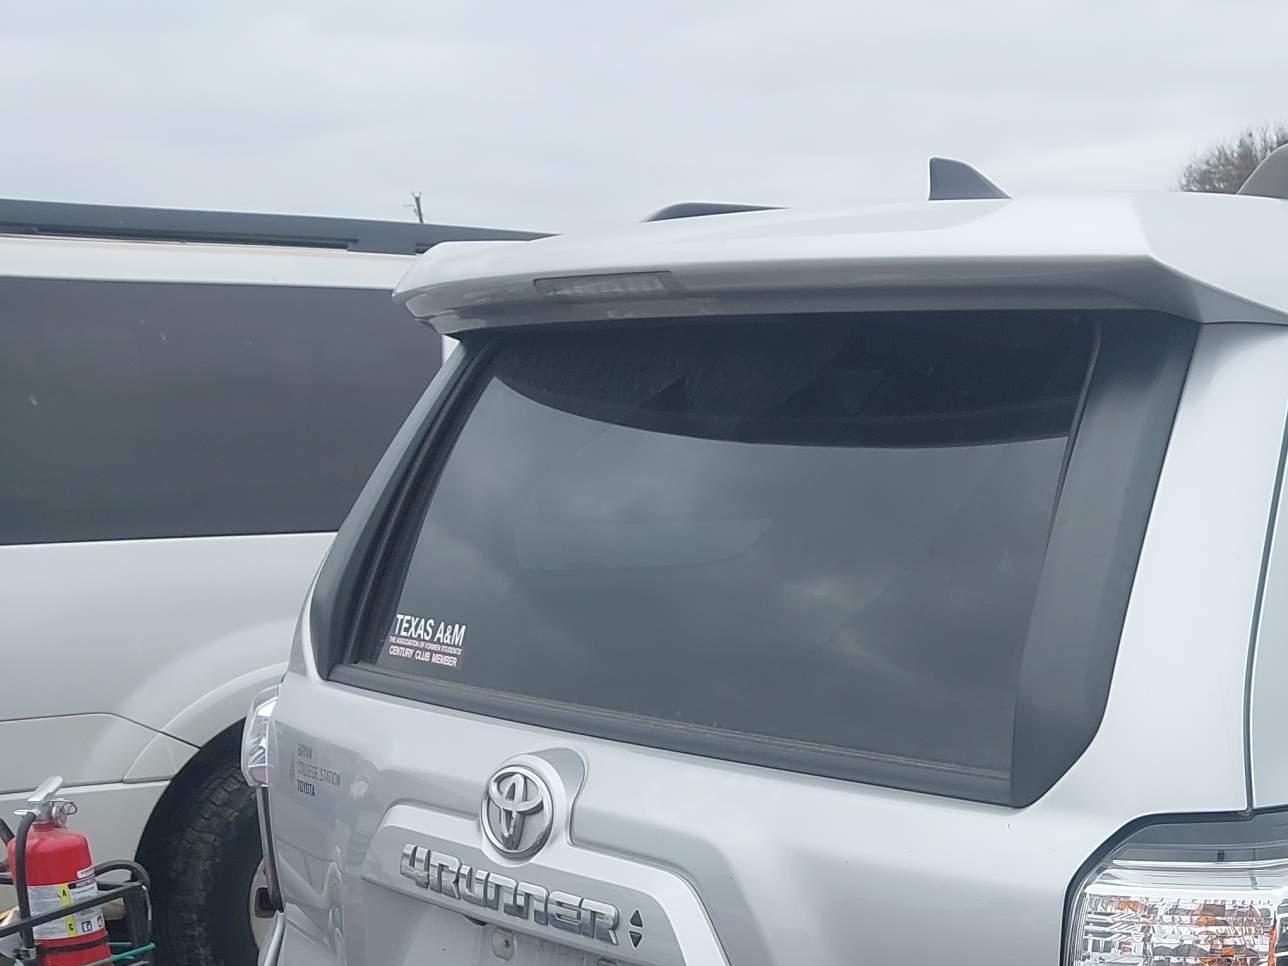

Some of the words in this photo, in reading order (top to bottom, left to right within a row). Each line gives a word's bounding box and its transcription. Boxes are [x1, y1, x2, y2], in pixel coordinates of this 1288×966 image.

[395, 614, 434, 640] TEXAS
[434, 621, 466, 647] A&M
[388, 645, 414, 658] CENTURY
[414, 650, 431, 662] CLUB
[431, 653, 458, 667] MEMBER
[297, 779, 315, 797] TOYOTA
[400, 843, 620, 945] 4RUNNER
